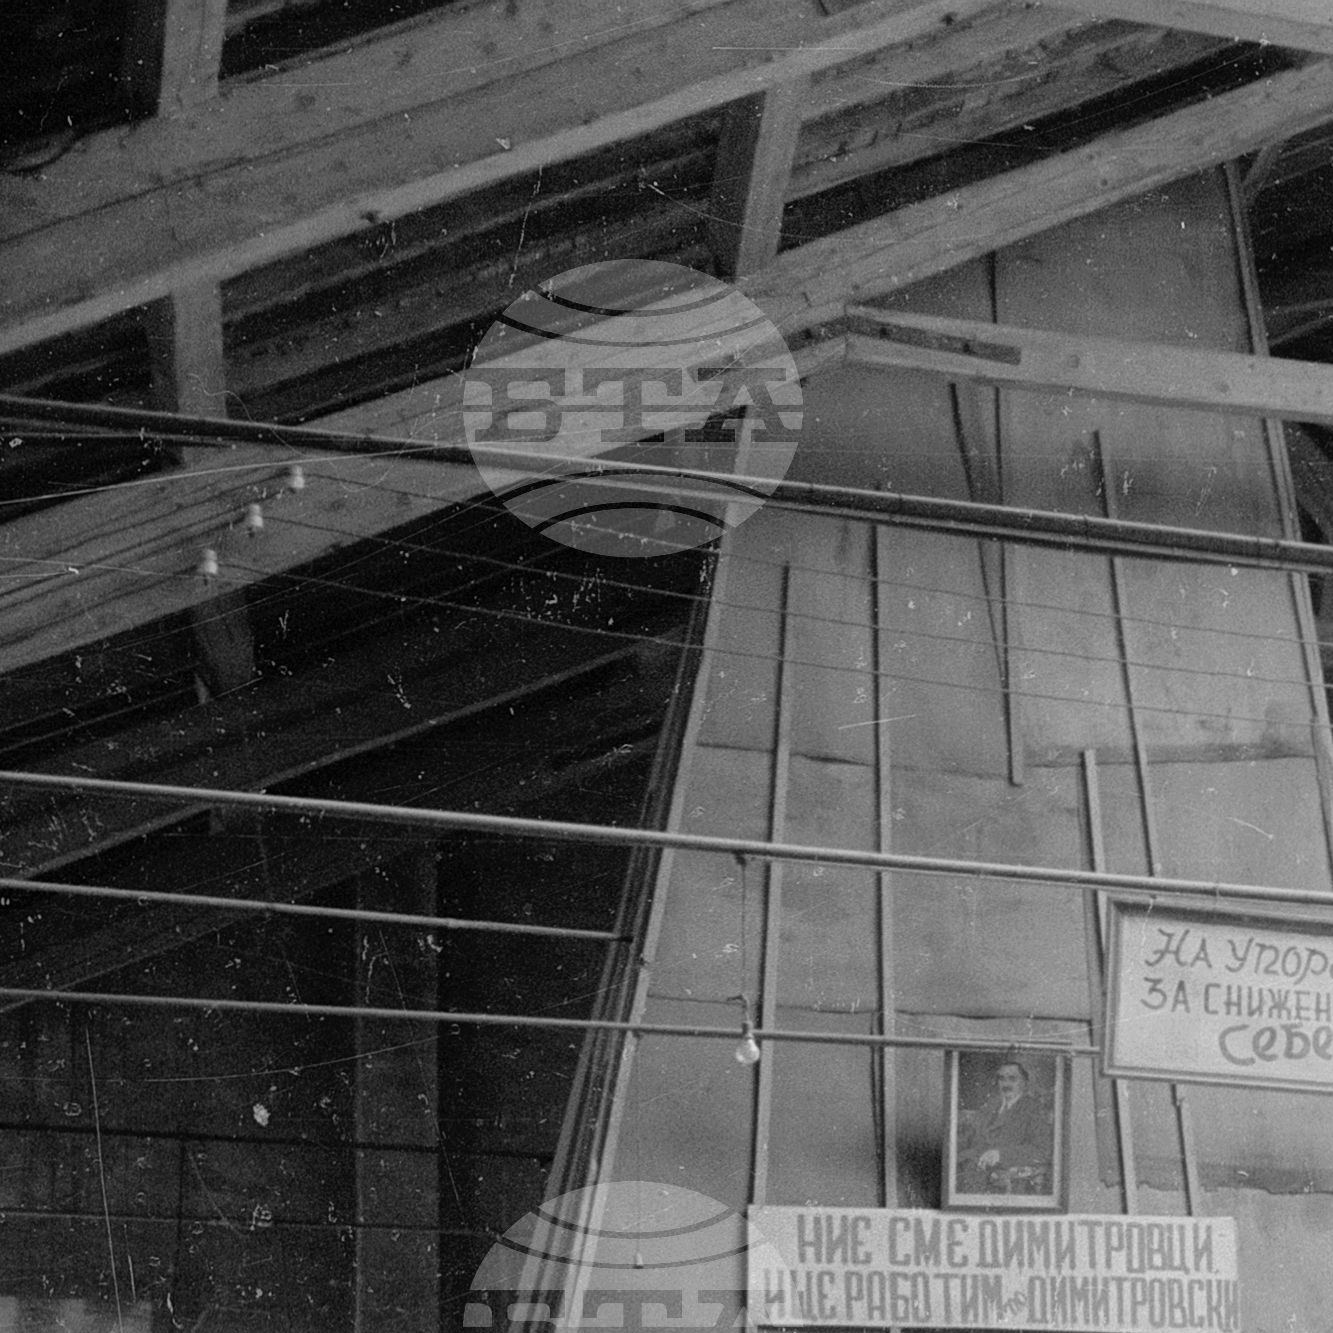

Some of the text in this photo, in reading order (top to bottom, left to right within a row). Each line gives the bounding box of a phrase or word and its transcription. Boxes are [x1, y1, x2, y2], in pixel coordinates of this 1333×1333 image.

[1145, 928, 1212, 968] НА
[1140, 977, 1190, 1013] ЗА
[798, 1213, 1214, 1275] НИЕ СМЕ ДИМИТРОВЦИ
[844, 1271, 1004, 1324] РАБОТИМ
[1027, 1275, 1239, 1333] ДИМИТРОВСКИ
